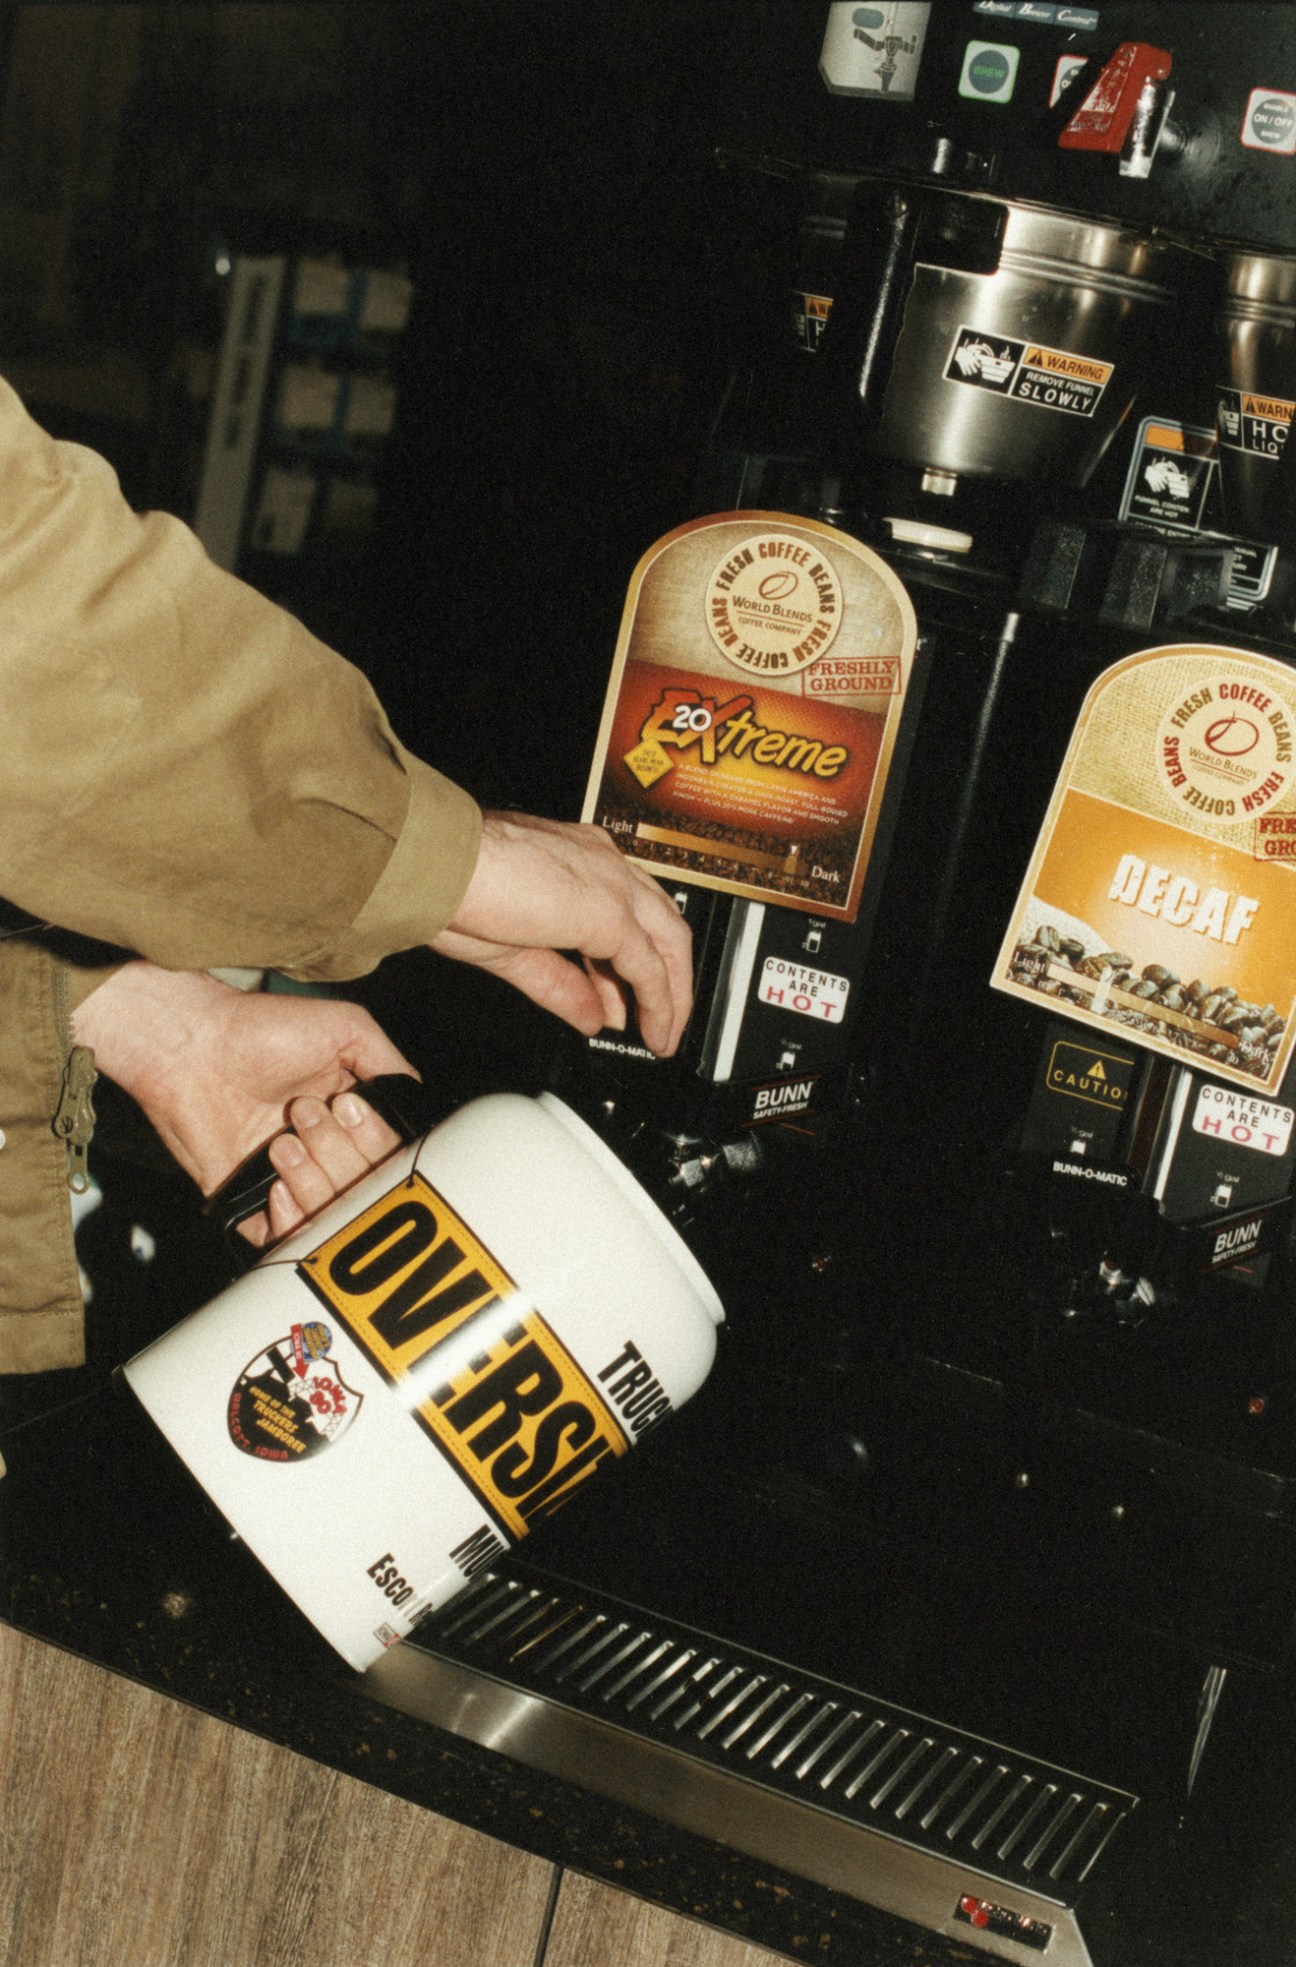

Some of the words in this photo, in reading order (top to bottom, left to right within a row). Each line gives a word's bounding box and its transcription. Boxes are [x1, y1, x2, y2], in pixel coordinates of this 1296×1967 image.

[1018, 4, 1052, 18] Brewer
[973, 65, 1004, 79] BREW
[1047, 356, 1105, 380] WARNING
[1019, 382, 1092, 411] SLOWLY
[1026, 371, 1065, 389] REMOVE
[1065, 381, 1095, 397] FUNNEL
[715, 547, 755, 592] FRESH
[758, 541, 812, 568] COFFEE
[807, 562, 835, 615] BEANS
[711, 597, 739, 649] BEANS
[732, 595, 771, 615] WORLD
[771, 603, 814, 624] BLENDS
[764, 622, 802, 637] COMPANY
[792, 619, 832, 663] FRESH
[735, 642, 789, 669] COFFEE
[808, 660, 896, 677] FRESHLY
[809, 676, 895, 693] GROUND
[1219, 683, 1272, 713] COFFEE
[672, 704, 712, 732] 20
[1171, 687, 1213, 729] FRESH
[1268, 710, 1293, 764] BEANS
[1163, 735, 1188, 788] BEANS
[1189, 746, 1223, 766] WORLD
[1223, 758, 1258, 780] BLENDS
[674, 780, 702, 793] COFFEE
[762, 801, 791, 814] FLAVOR
[808, 812, 839, 826] SMOOTH
[1182, 785, 1236, 816] COFFEE
[1241, 771, 1285, 813] FRESH
[602, 815, 634, 834] Light
[811, 865, 841, 884] Dark
[1107, 852, 1261, 946] DECAF
[766, 959, 848, 993] CONTENTS
[1014, 951, 1048, 974] Light
[766, 985, 838, 1018] HOT
[788, 980, 819, 998] ARE
[755, 1082, 813, 1109] BUNN
[1053, 1070, 1128, 1101] CAUTIO
[753, 1101, 808, 1120] SAFETY-FRESH
[1202, 1087, 1292, 1124] CONTENTS
[1227, 1110, 1261, 1128] ARE
[1201, 1116, 1280, 1151] HOT
[1053, 1161, 1128, 1187] BUNN-O-MATIC
[1214, 1219, 1262, 1254] BUNN
[1212, 1240, 1257, 1264] SAFETY-FRESH
[249, 1386, 272, 1402] HOME
[269, 1399, 282, 1409] OF
[280, 1405, 296, 1419] THE
[309, 1390, 331, 1415] 80
[313, 1376, 347, 1415] IOWA
[253, 1399, 299, 1434] TRUCKERS
[255, 1418, 307, 1454] JAMBOREE
